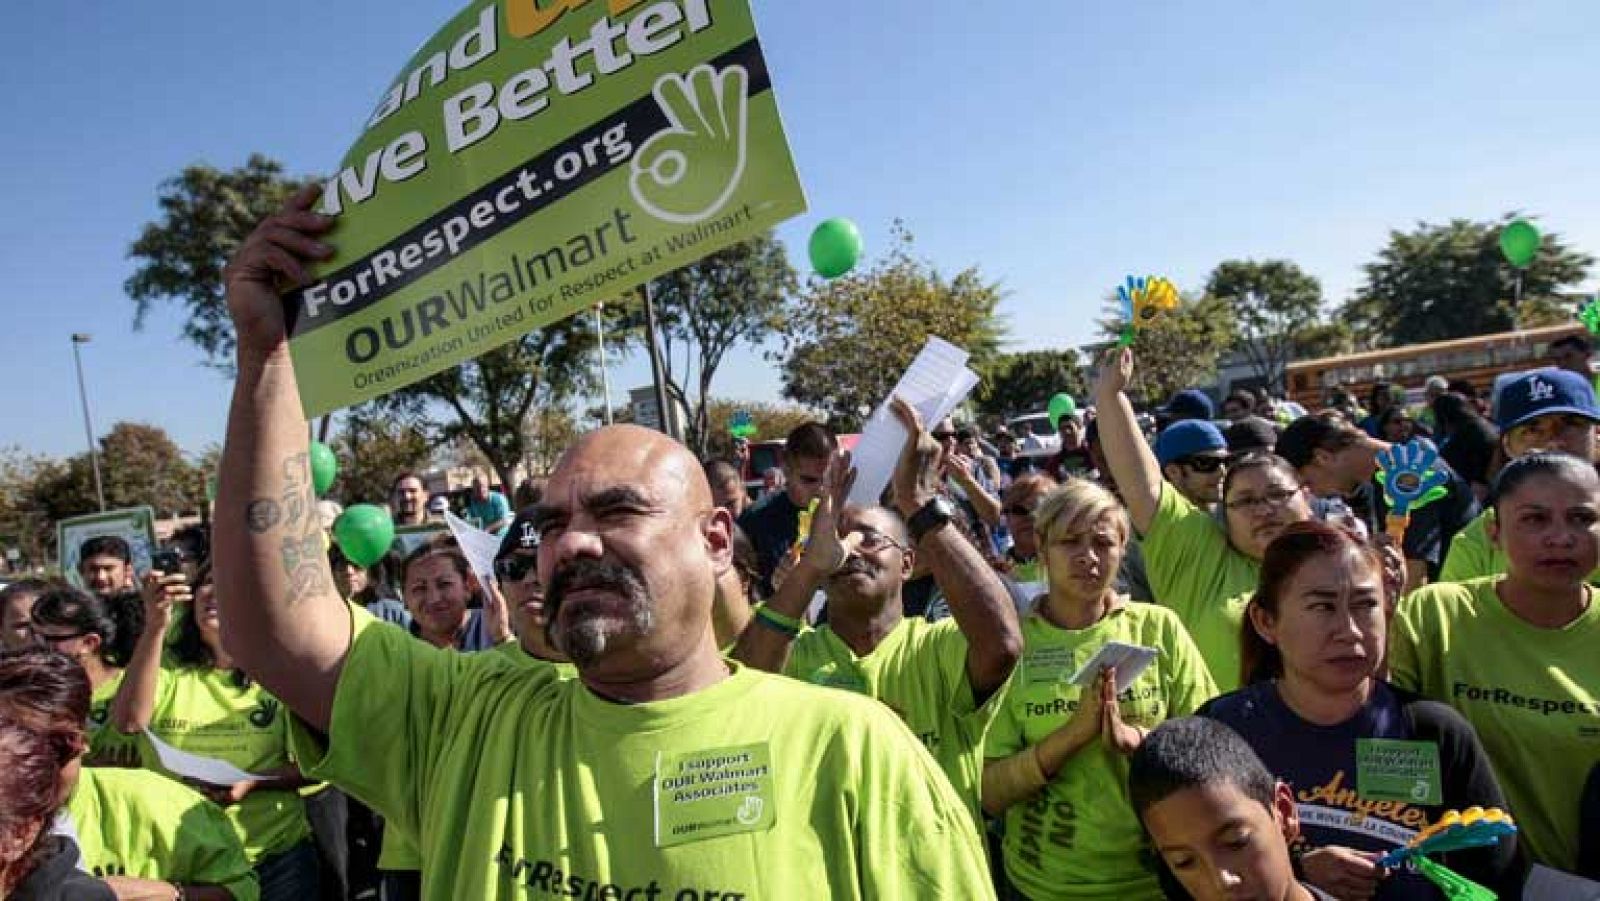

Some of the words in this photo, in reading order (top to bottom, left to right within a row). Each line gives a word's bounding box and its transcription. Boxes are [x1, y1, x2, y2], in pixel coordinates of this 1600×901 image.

[315, 129, 430, 218] ive
[301, 121, 633, 319] ForRespect.org
[345, 206, 638, 365] OURWalmart
[353, 336, 464, 389] Organization
[466, 305, 524, 343] United
[527, 292, 556, 316] for
[559, 256, 637, 301] Respect
[641, 245, 662, 266] at
[666, 203, 754, 252] Walmart
[673, 782, 759, 802] Associates
[687, 753, 749, 770] support
[699, 764, 768, 783] Walmart
